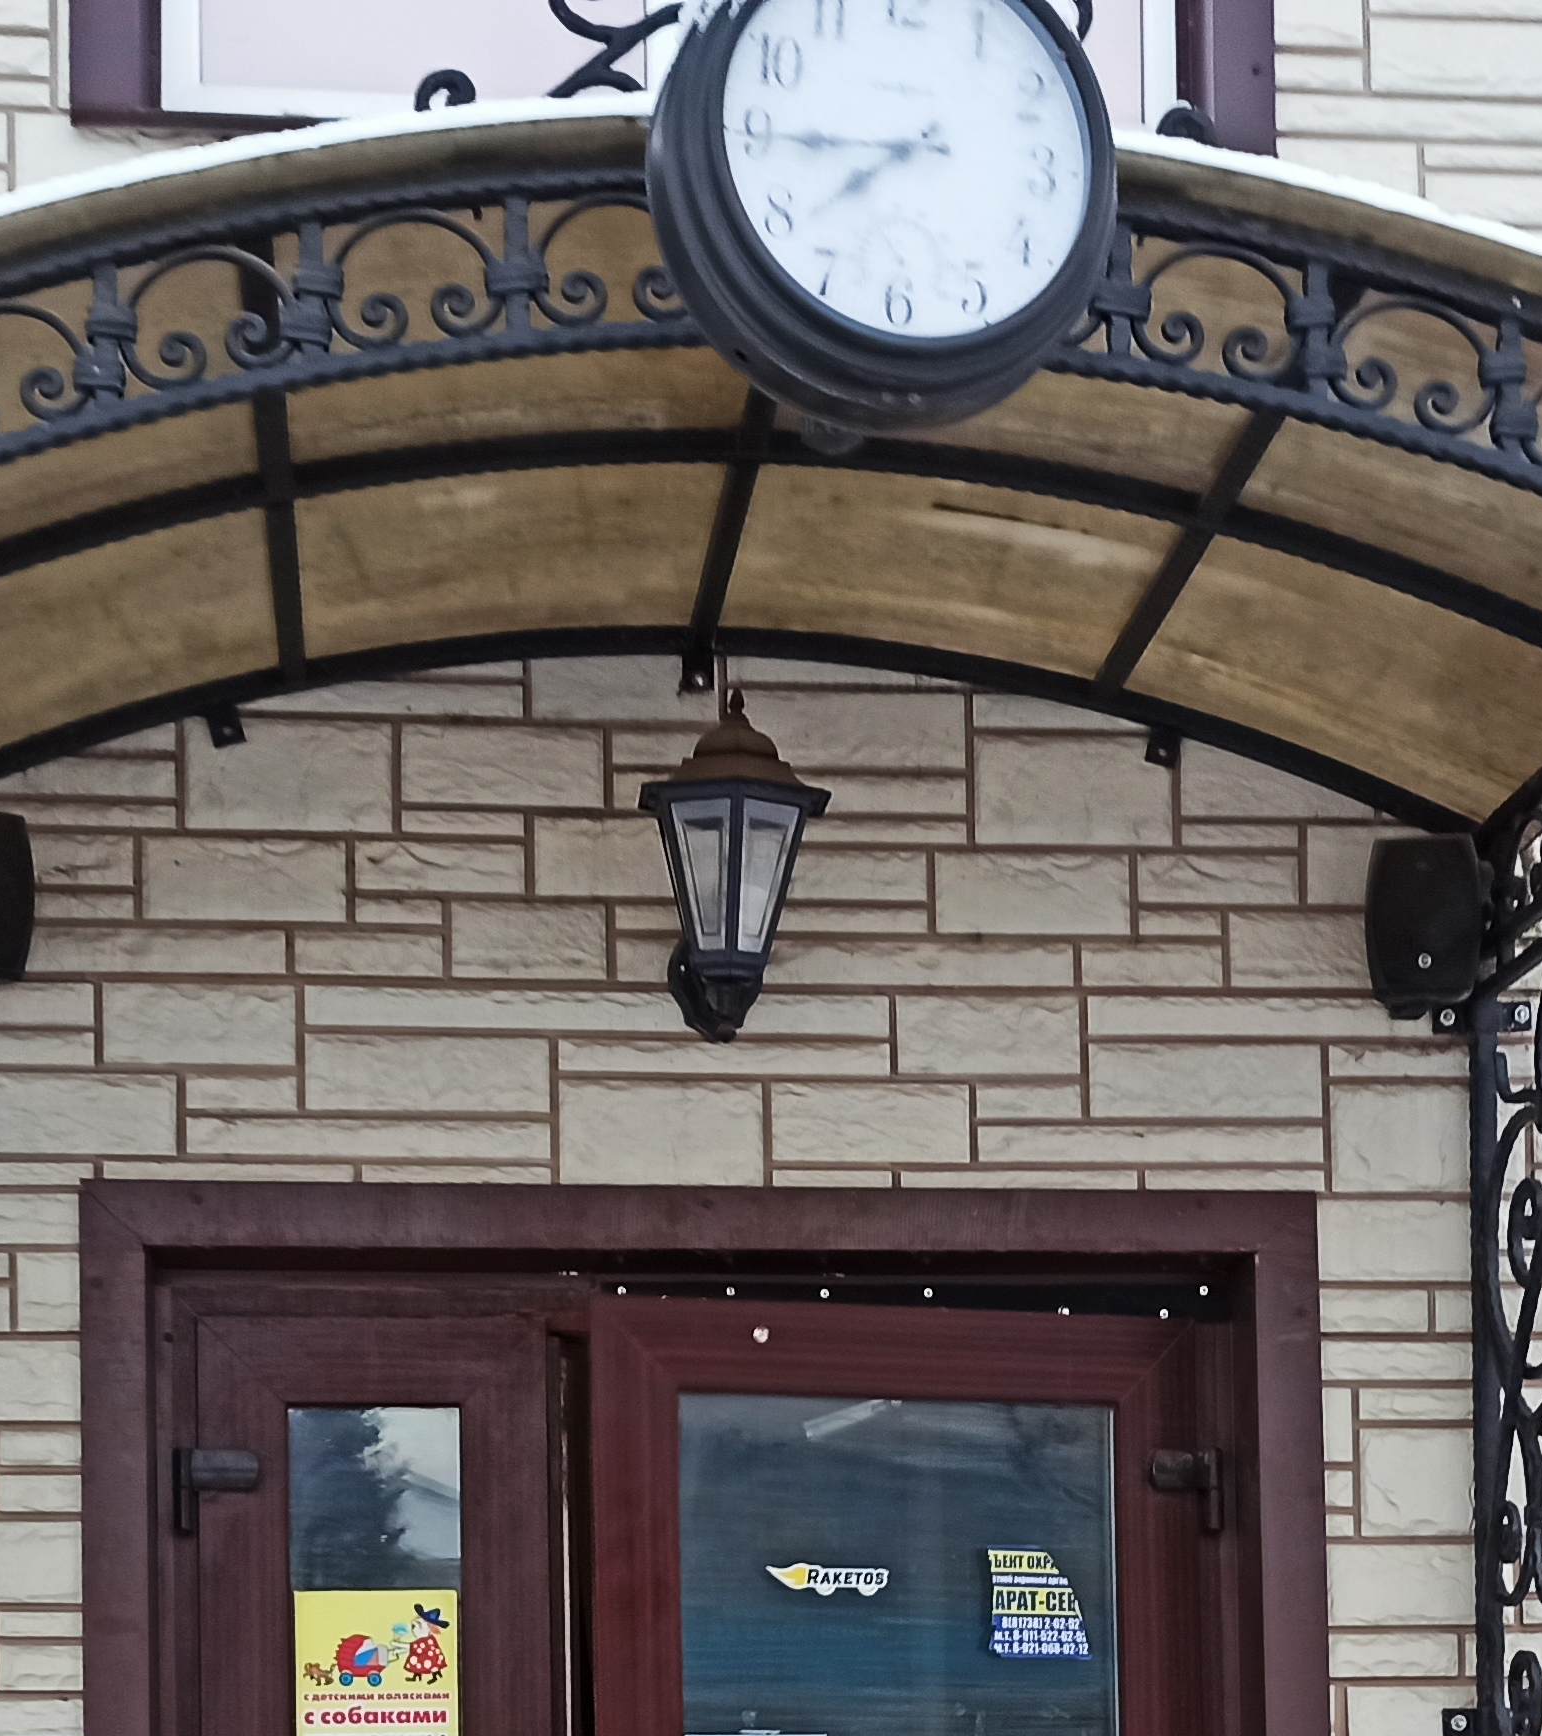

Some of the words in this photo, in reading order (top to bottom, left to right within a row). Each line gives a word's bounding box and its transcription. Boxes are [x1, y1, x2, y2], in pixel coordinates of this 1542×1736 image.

[761, 33, 804, 88] 10
[744, 108, 772, 158] 9
[764, 185, 793, 239] 8
[814, 247, 836, 296] 7
[883, 277, 913, 327] 6
[806, 1568, 885, 1585] RAKETOS
[304, 1711, 315, 1725] с
[320, 1706, 447, 1725] собаками
[311, 1693, 375, 1702] детскими
[377, 1692, 450, 1701] колясками
